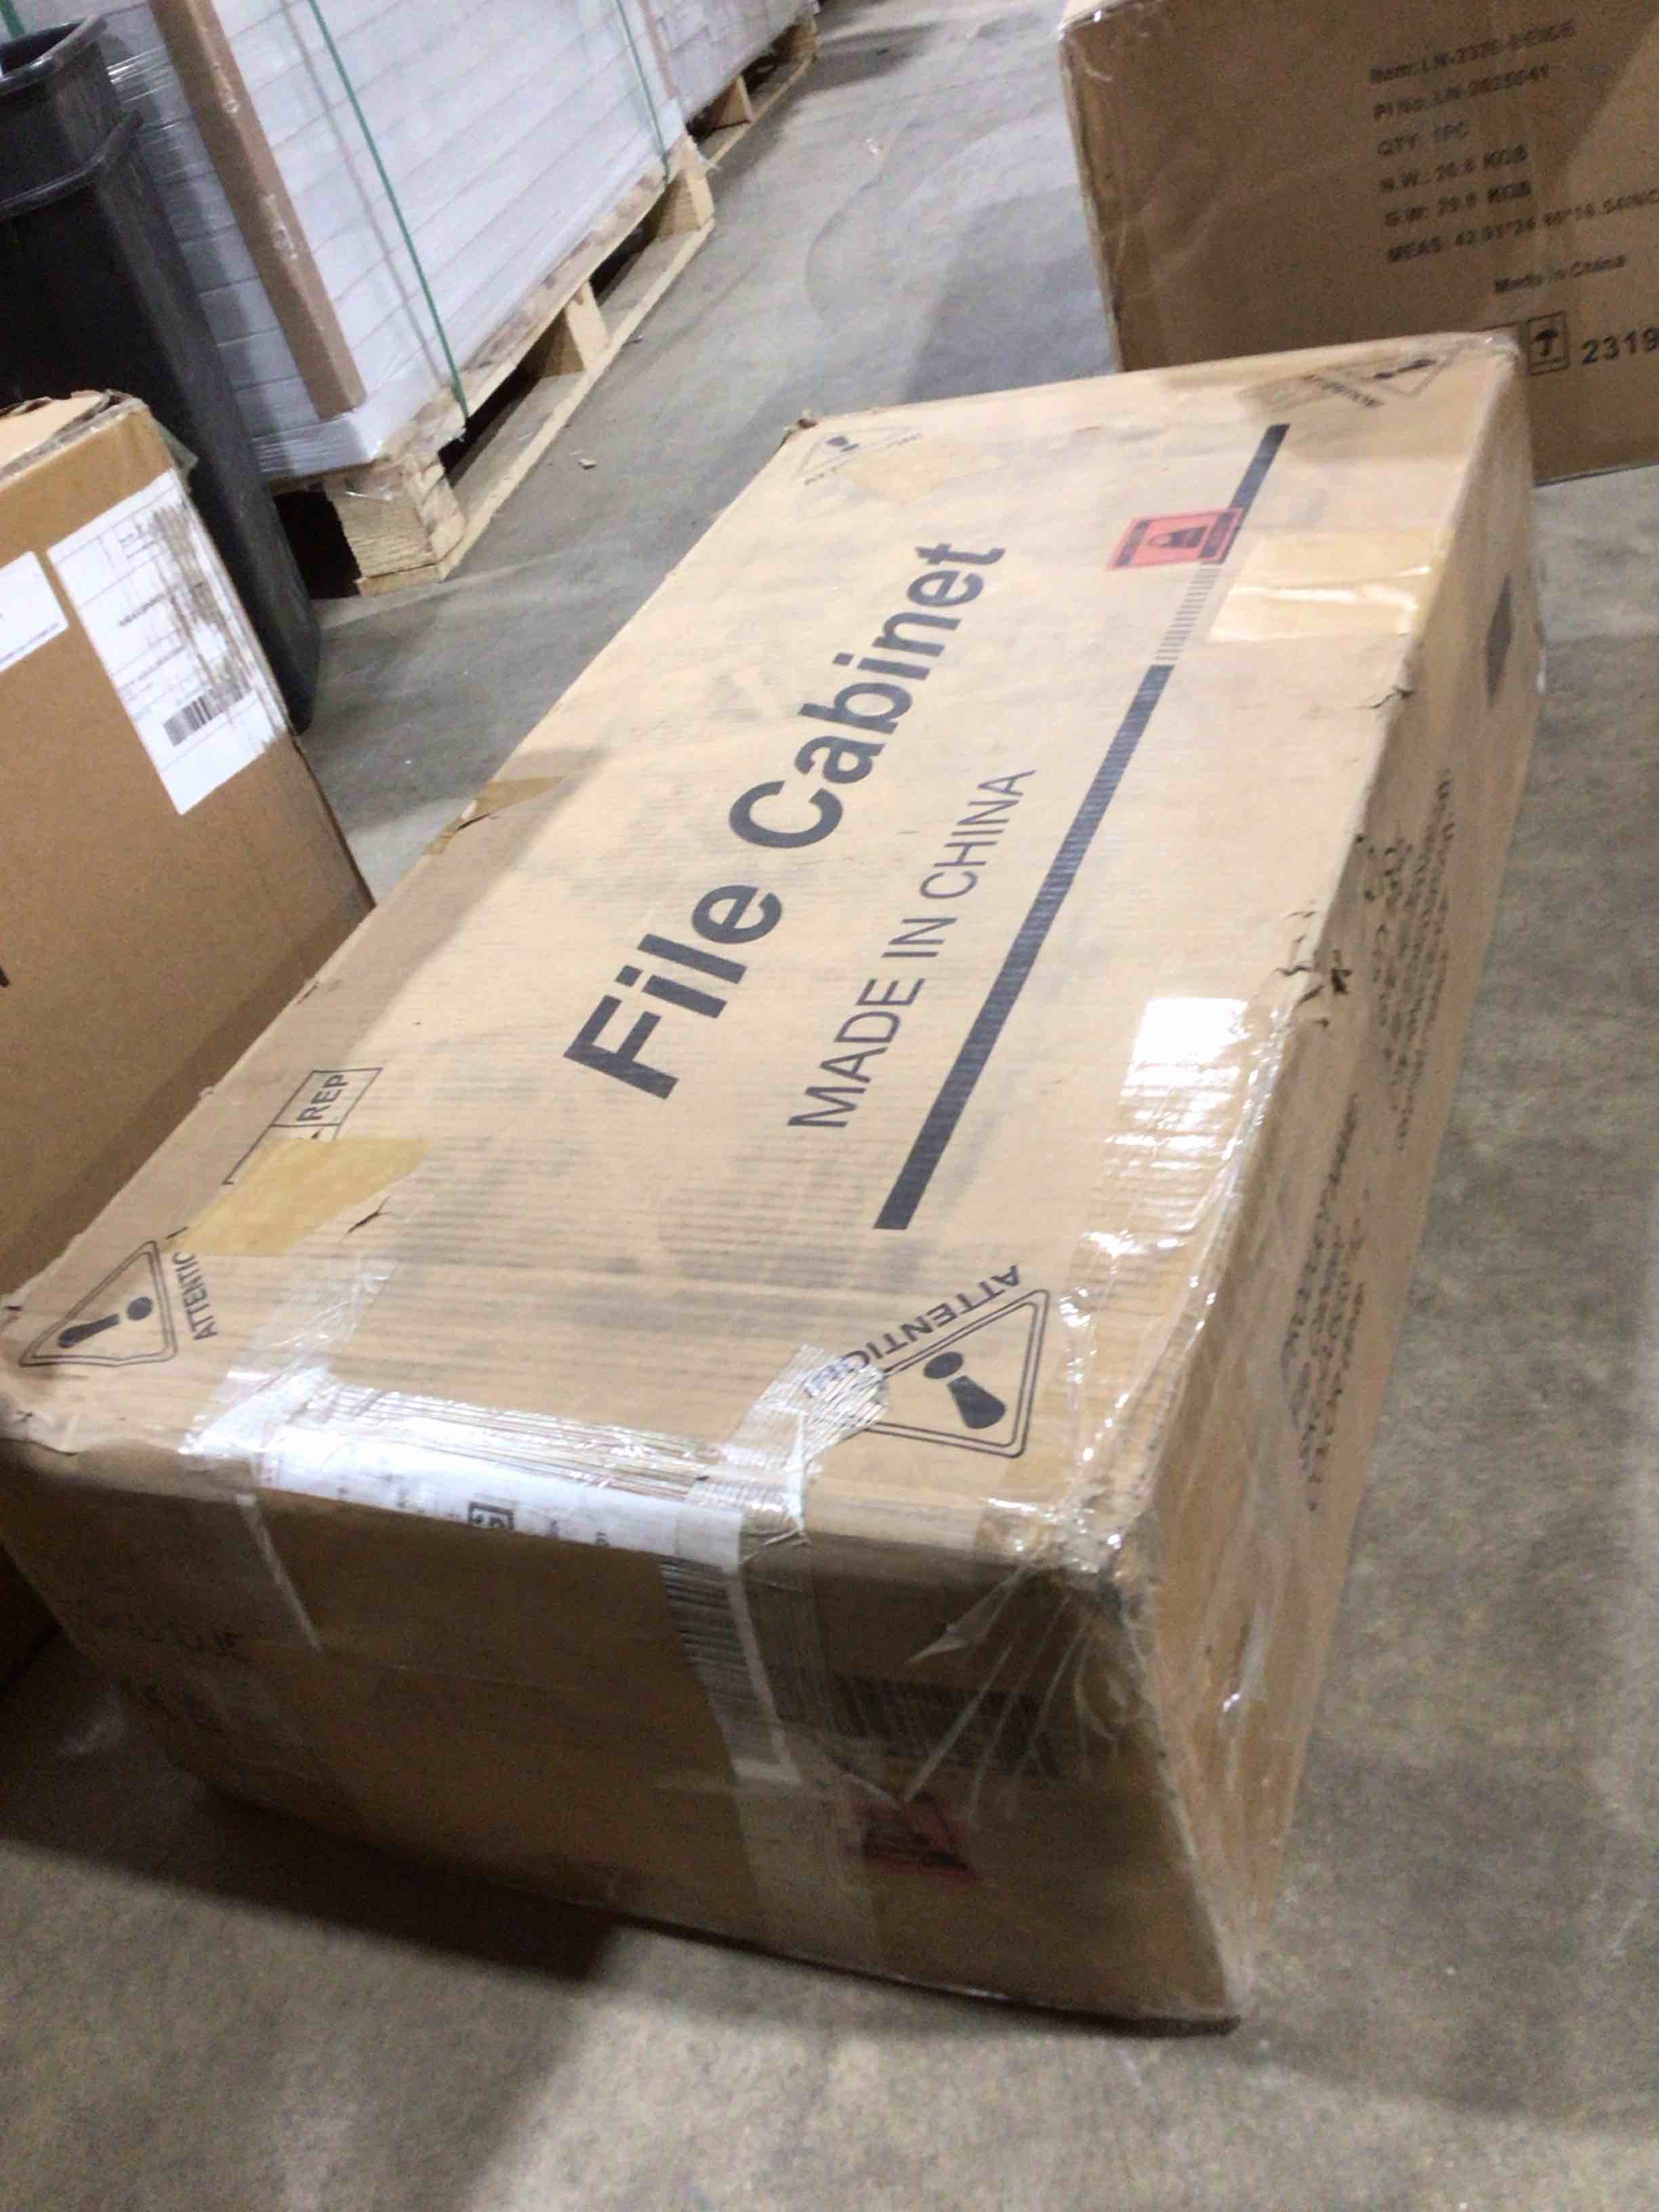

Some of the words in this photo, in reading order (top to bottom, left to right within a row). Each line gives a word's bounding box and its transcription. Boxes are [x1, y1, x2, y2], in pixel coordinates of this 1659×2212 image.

[562, 884, 783, 1100] File
[729, 542, 1006, 849] Cabinet
[786, 979, 924, 1128] MADE
[882, 917, 958, 958] IN
[920, 769, 1037, 900] CHINA
[295, 1073, 350, 1122] REP
